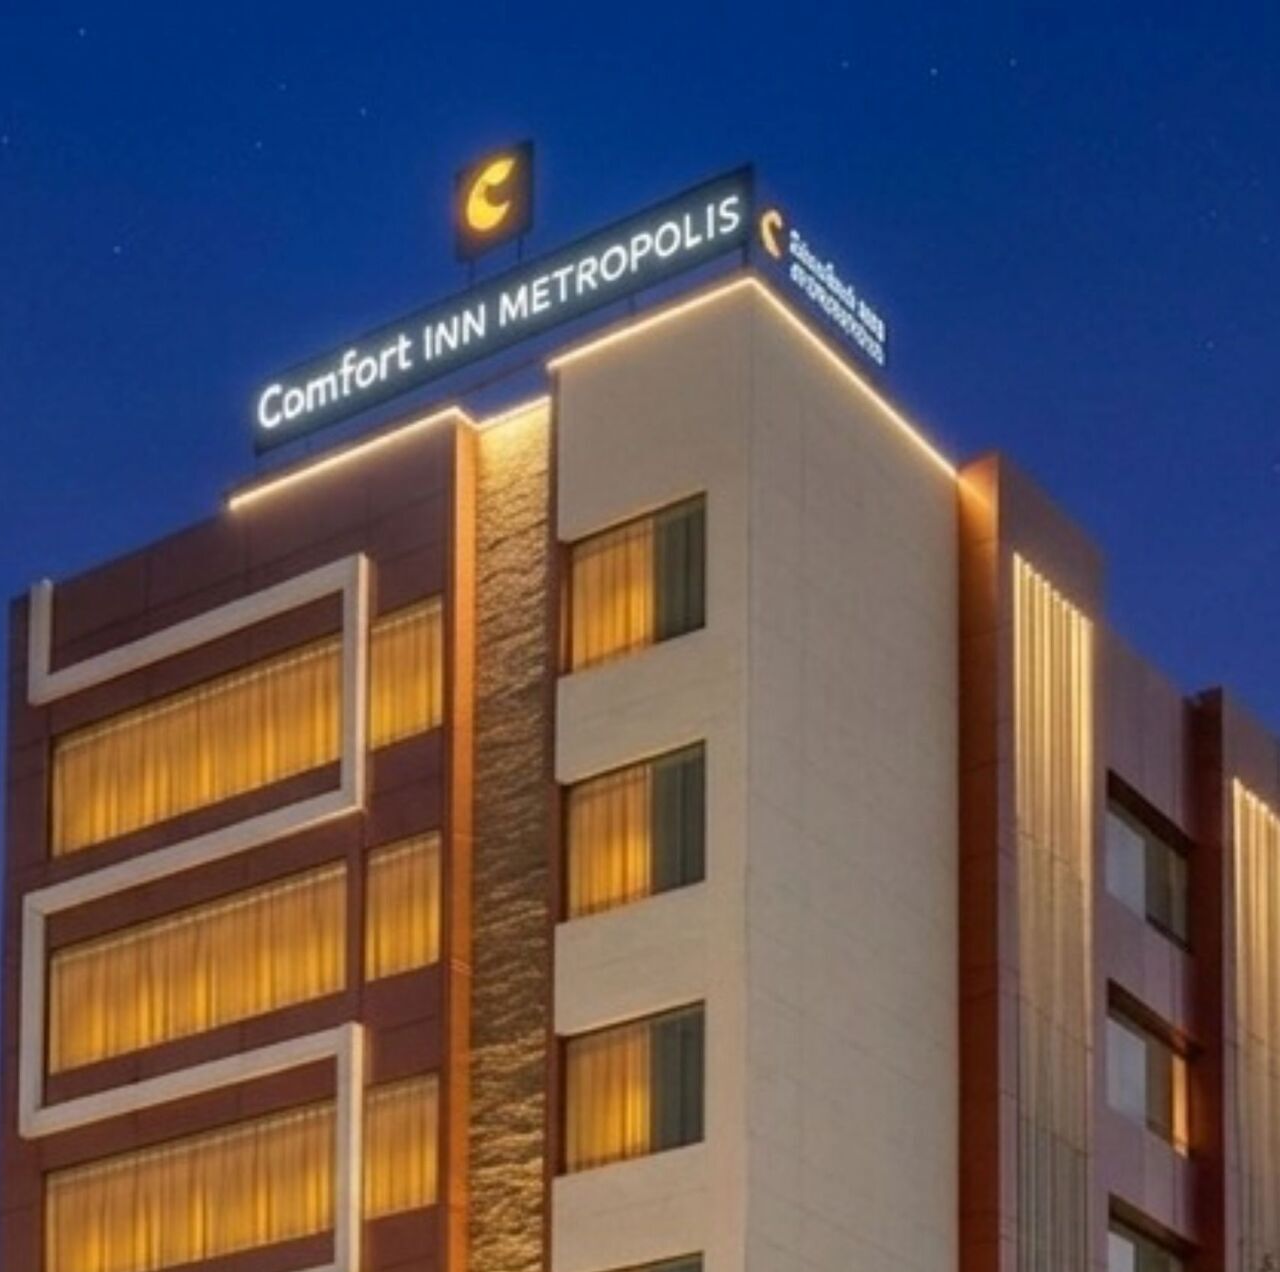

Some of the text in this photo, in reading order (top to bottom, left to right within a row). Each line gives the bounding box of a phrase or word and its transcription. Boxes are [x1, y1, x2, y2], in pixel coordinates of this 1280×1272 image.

[257, 334, 412, 428] Comfort
[424, 302, 486, 361] INN
[498, 194, 740, 327] METROPOLIS
